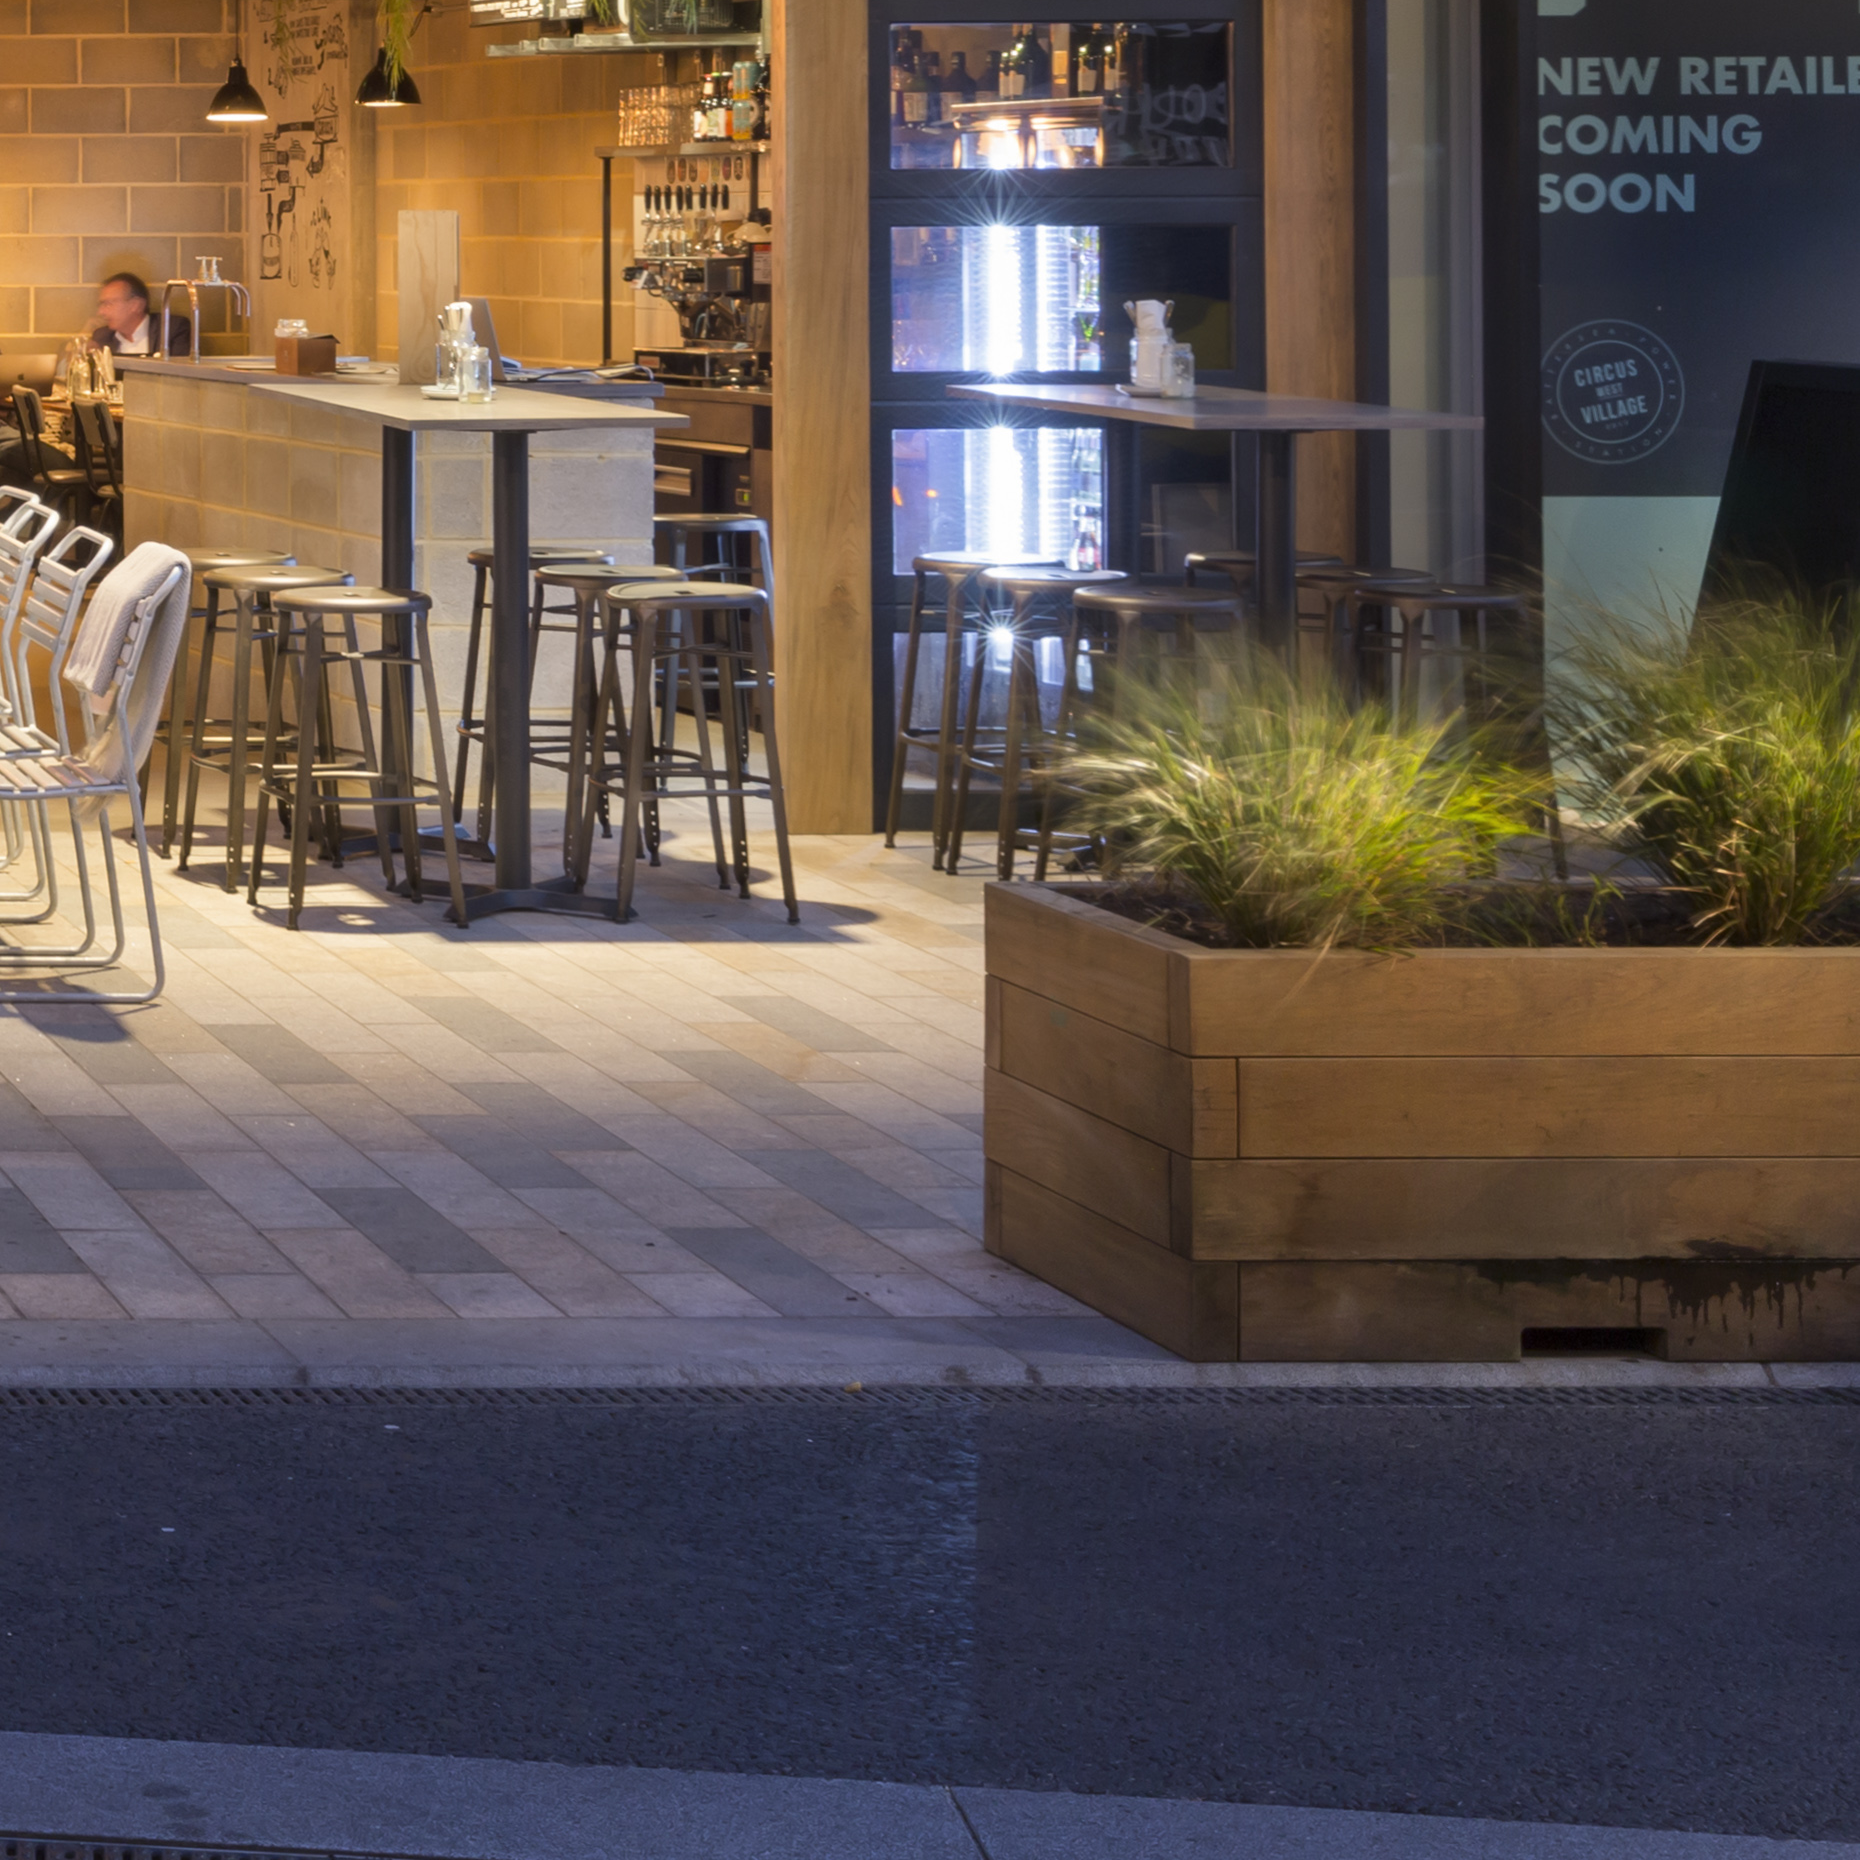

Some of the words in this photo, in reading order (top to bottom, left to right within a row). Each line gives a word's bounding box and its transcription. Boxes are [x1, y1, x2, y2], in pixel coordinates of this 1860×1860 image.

[1538, 57, 1660, 95] NEW
[1538, 114, 1763, 155] COMING
[1538, 172, 1696, 214] SOON
[1574, 359, 1638, 387] CIRCUS
[1595, 382, 1623, 397] WEST
[1580, 395, 1648, 425] VILLAGE
